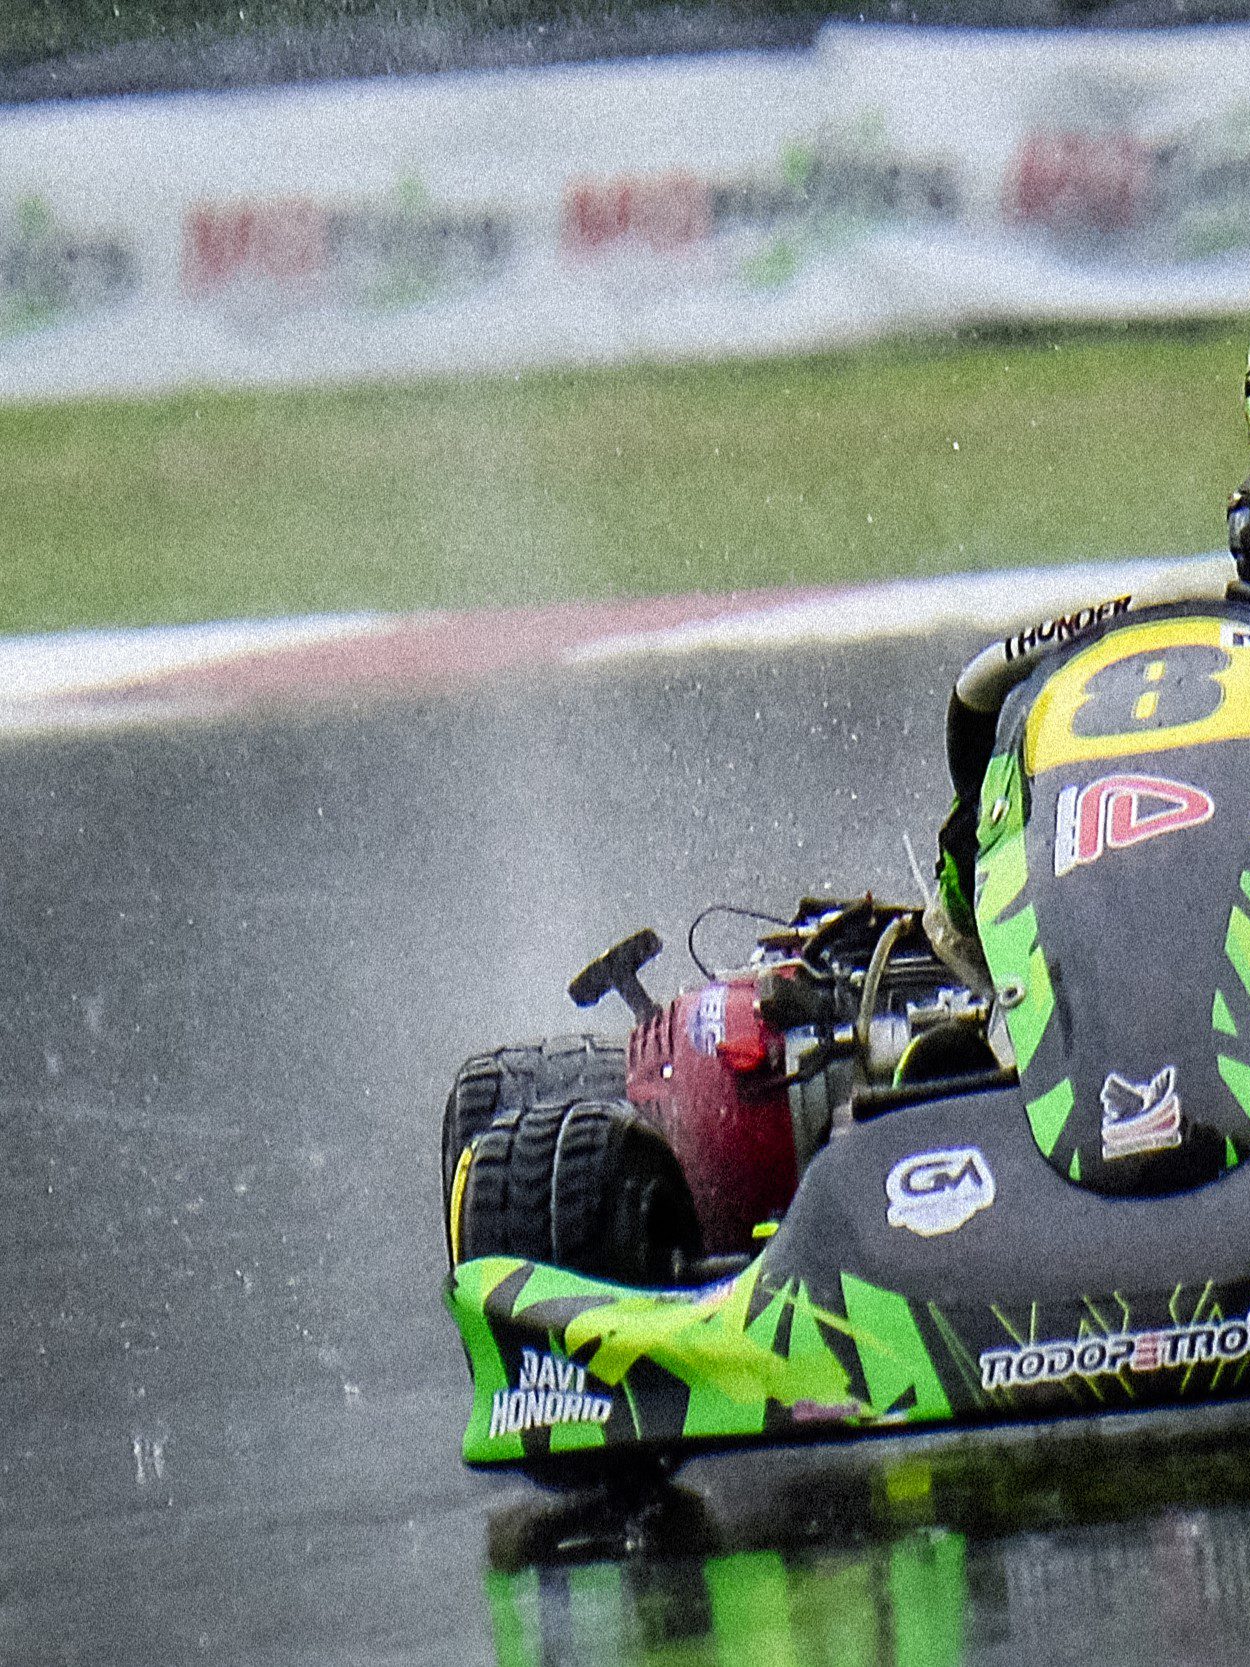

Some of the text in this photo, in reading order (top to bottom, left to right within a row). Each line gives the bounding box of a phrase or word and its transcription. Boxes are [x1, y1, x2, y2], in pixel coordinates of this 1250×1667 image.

[1004, 594, 1133, 661] THUNDER
[1071, 644, 1231, 738] 8
[900, 1156, 983, 1197] GM
[980, 1318, 1249, 1391] RODOPETRO
[490, 1388, 613, 1440] HONORIO
